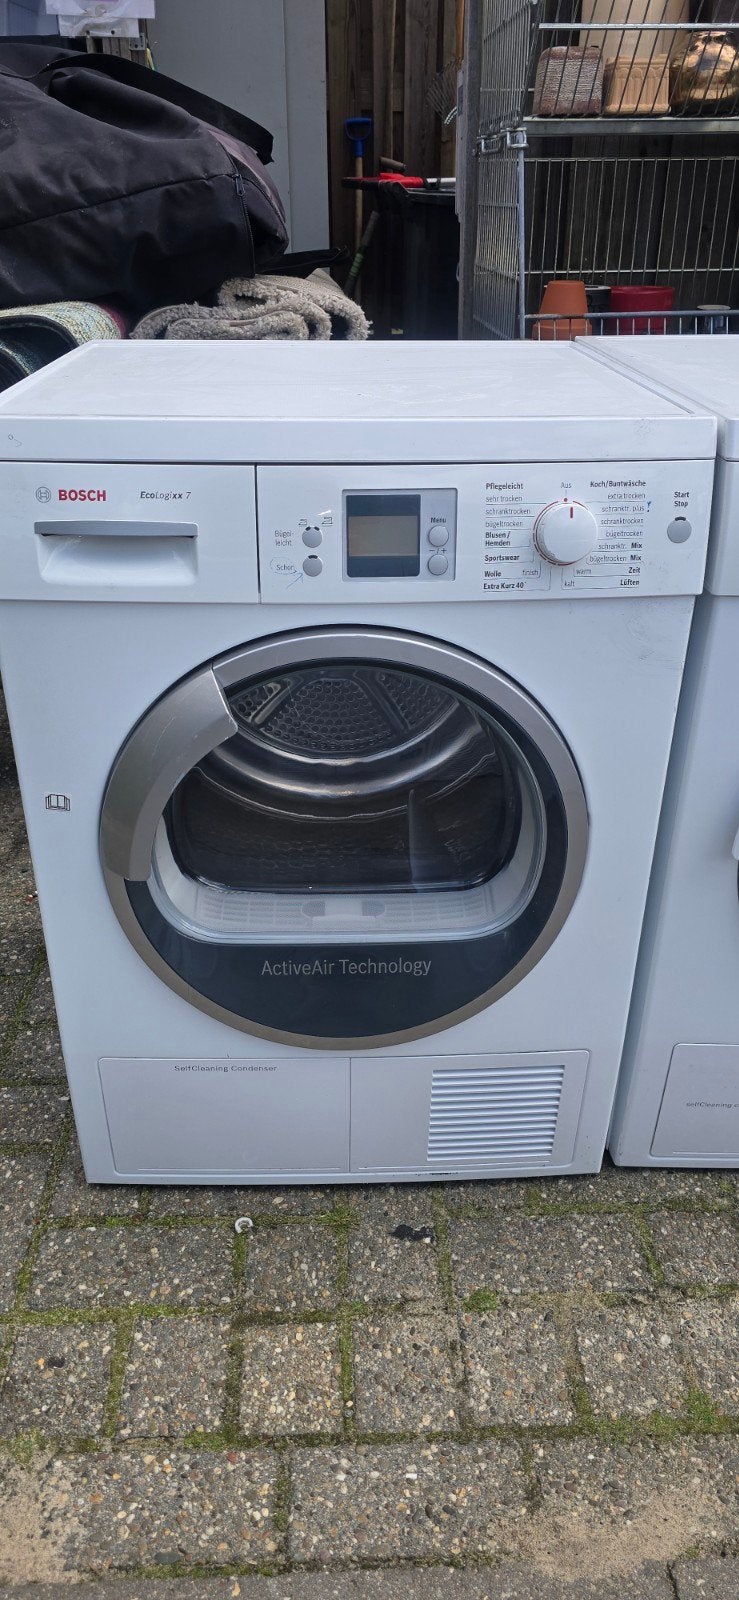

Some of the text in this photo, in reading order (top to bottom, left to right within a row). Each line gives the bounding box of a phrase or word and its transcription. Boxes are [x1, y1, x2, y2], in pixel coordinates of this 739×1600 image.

[486, 482, 523, 490] Pflegeleicht
[590, 480, 646, 488] Koch/Buntwäsche
[58, 489, 106, 501] BOSCH
[140, 491, 183, 500] EcoLogixx
[484, 554, 520, 562] Sportswear
[261, 958, 432, 976] ActiveAir Technology
[174, 1064, 278, 1072] SelfCleaning Condenser
